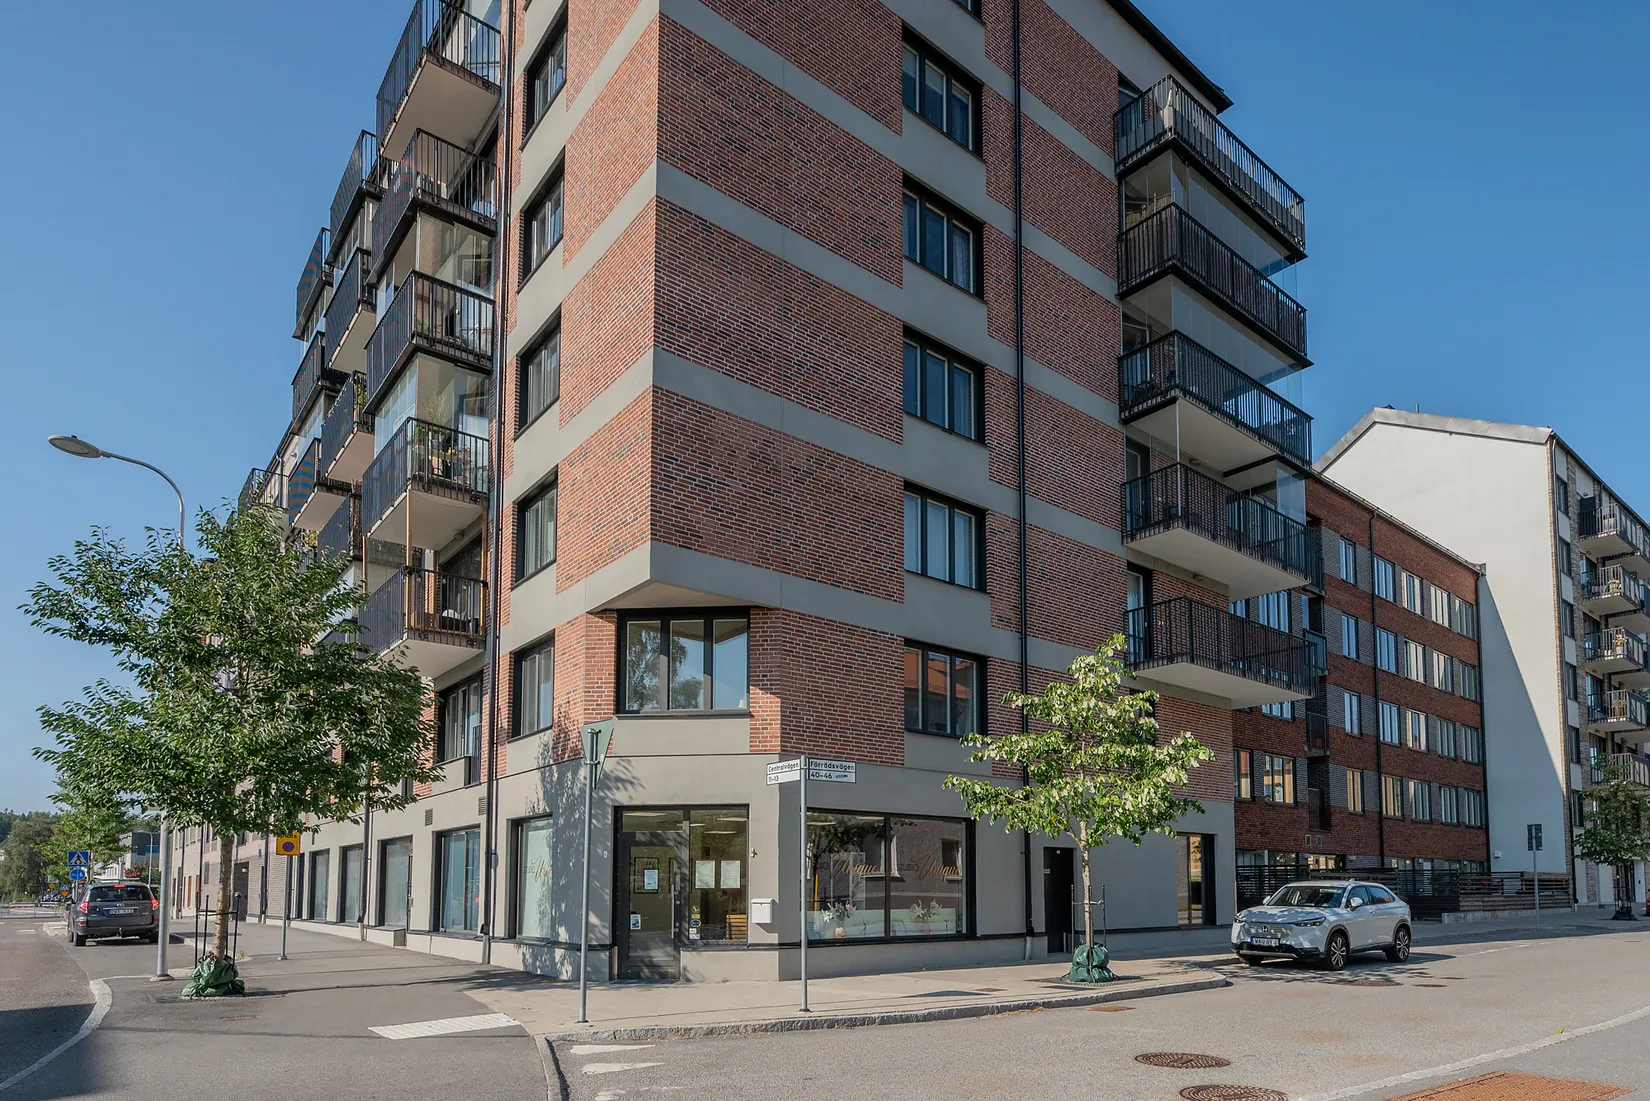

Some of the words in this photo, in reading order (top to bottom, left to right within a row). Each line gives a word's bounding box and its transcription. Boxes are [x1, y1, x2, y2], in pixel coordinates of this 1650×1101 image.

[769, 762, 799, 772] Centralvägen
[811, 761, 854, 771] Förrådsvägen
[831, 856, 880, 881] Unique
